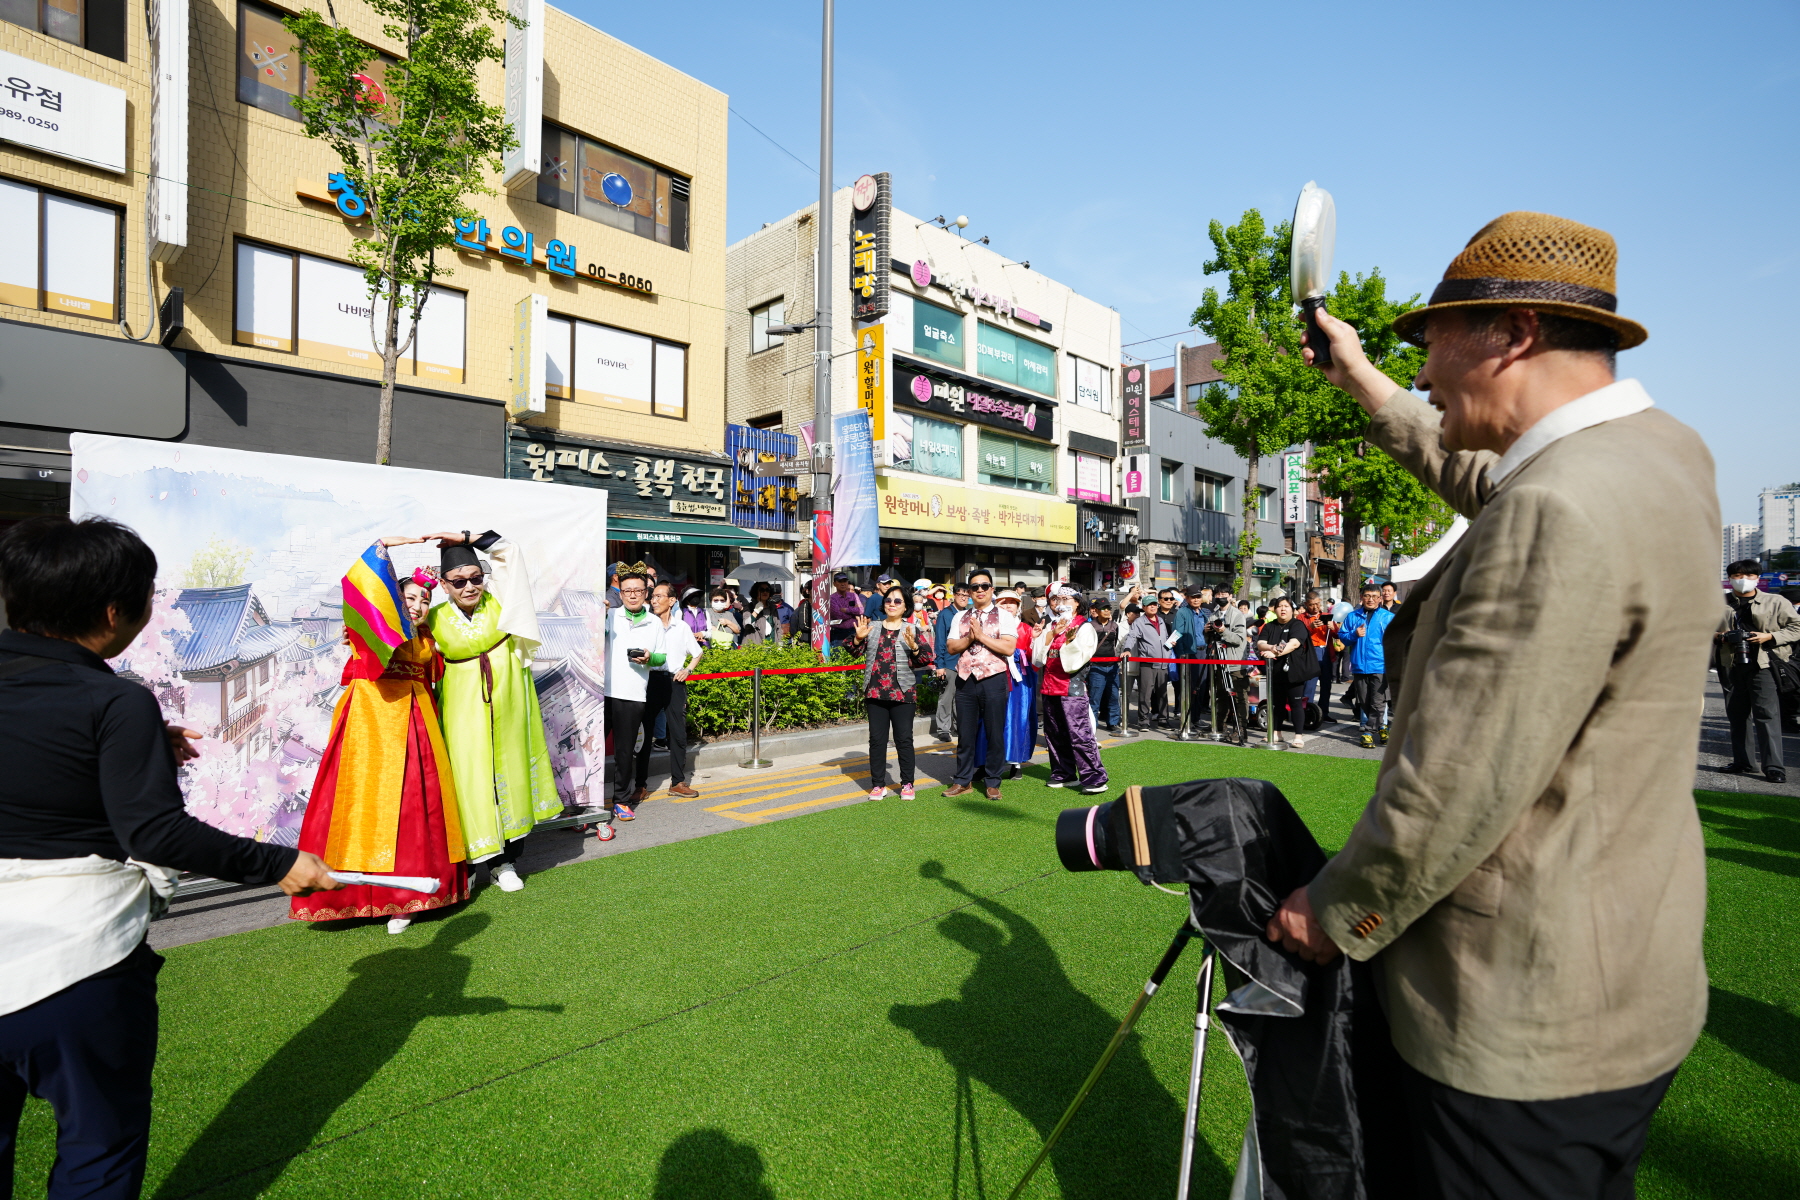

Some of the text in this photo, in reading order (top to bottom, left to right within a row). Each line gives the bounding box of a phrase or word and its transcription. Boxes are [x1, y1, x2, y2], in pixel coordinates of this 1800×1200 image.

[0, 76, 62, 112] 유점
[453, 217, 577, 277] 한의원
[855, 230, 877, 298] 노래방
[936, 271, 966, 304] 미원
[59, 297, 91, 310] 나비엘
[338, 302, 372, 318] 나비엘
[923, 324, 956, 345] 얼굴축소
[1023, 358, 1049, 376] 하체관리
[933, 381, 965, 413] 미원
[1126, 383, 1142, 395] 미원
[1128, 397, 1140, 438] 에스테틱
[985, 452, 1007, 468] 속눈썹
[681, 465, 725, 500] 천국
[1288, 456, 1302, 494] 삼천포
[884, 494, 931, 517] 원할머니
[998, 510, 1045, 528] 박가부대찌개
